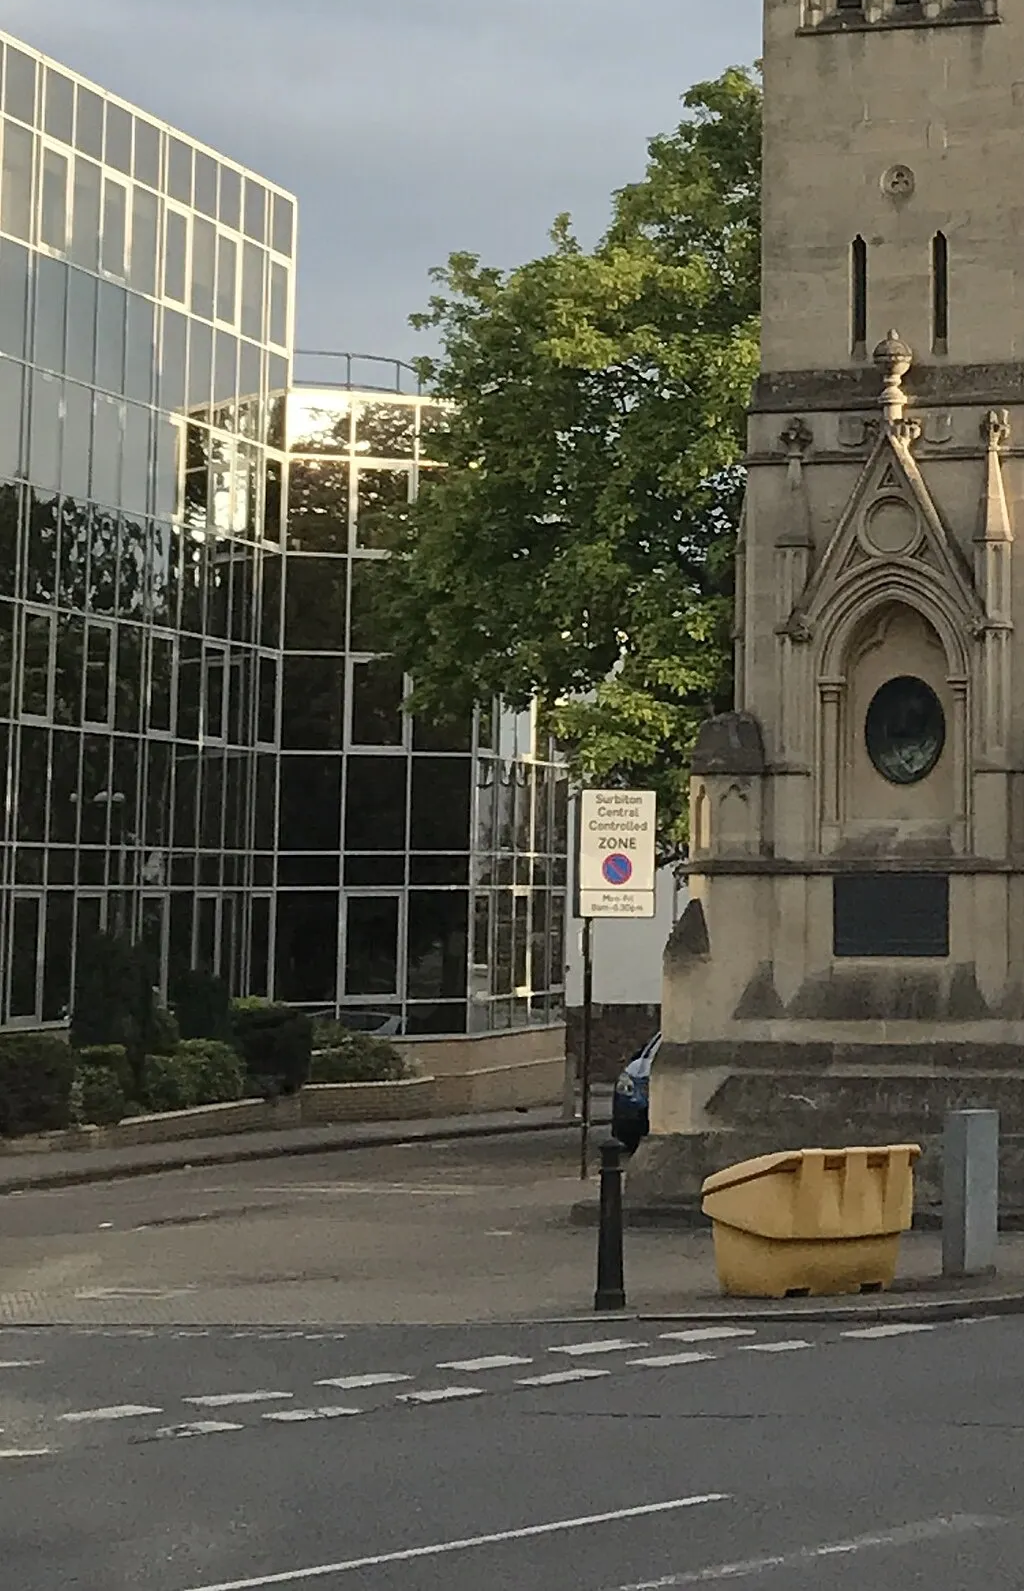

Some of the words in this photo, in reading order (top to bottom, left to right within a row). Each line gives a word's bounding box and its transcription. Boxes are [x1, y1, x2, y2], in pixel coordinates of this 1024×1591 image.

[595, 793, 643, 804] Surbiton
[597, 806, 640, 817] Central
[589, 820, 648, 831] Controlled
[598, 837, 637, 849] ZONE
